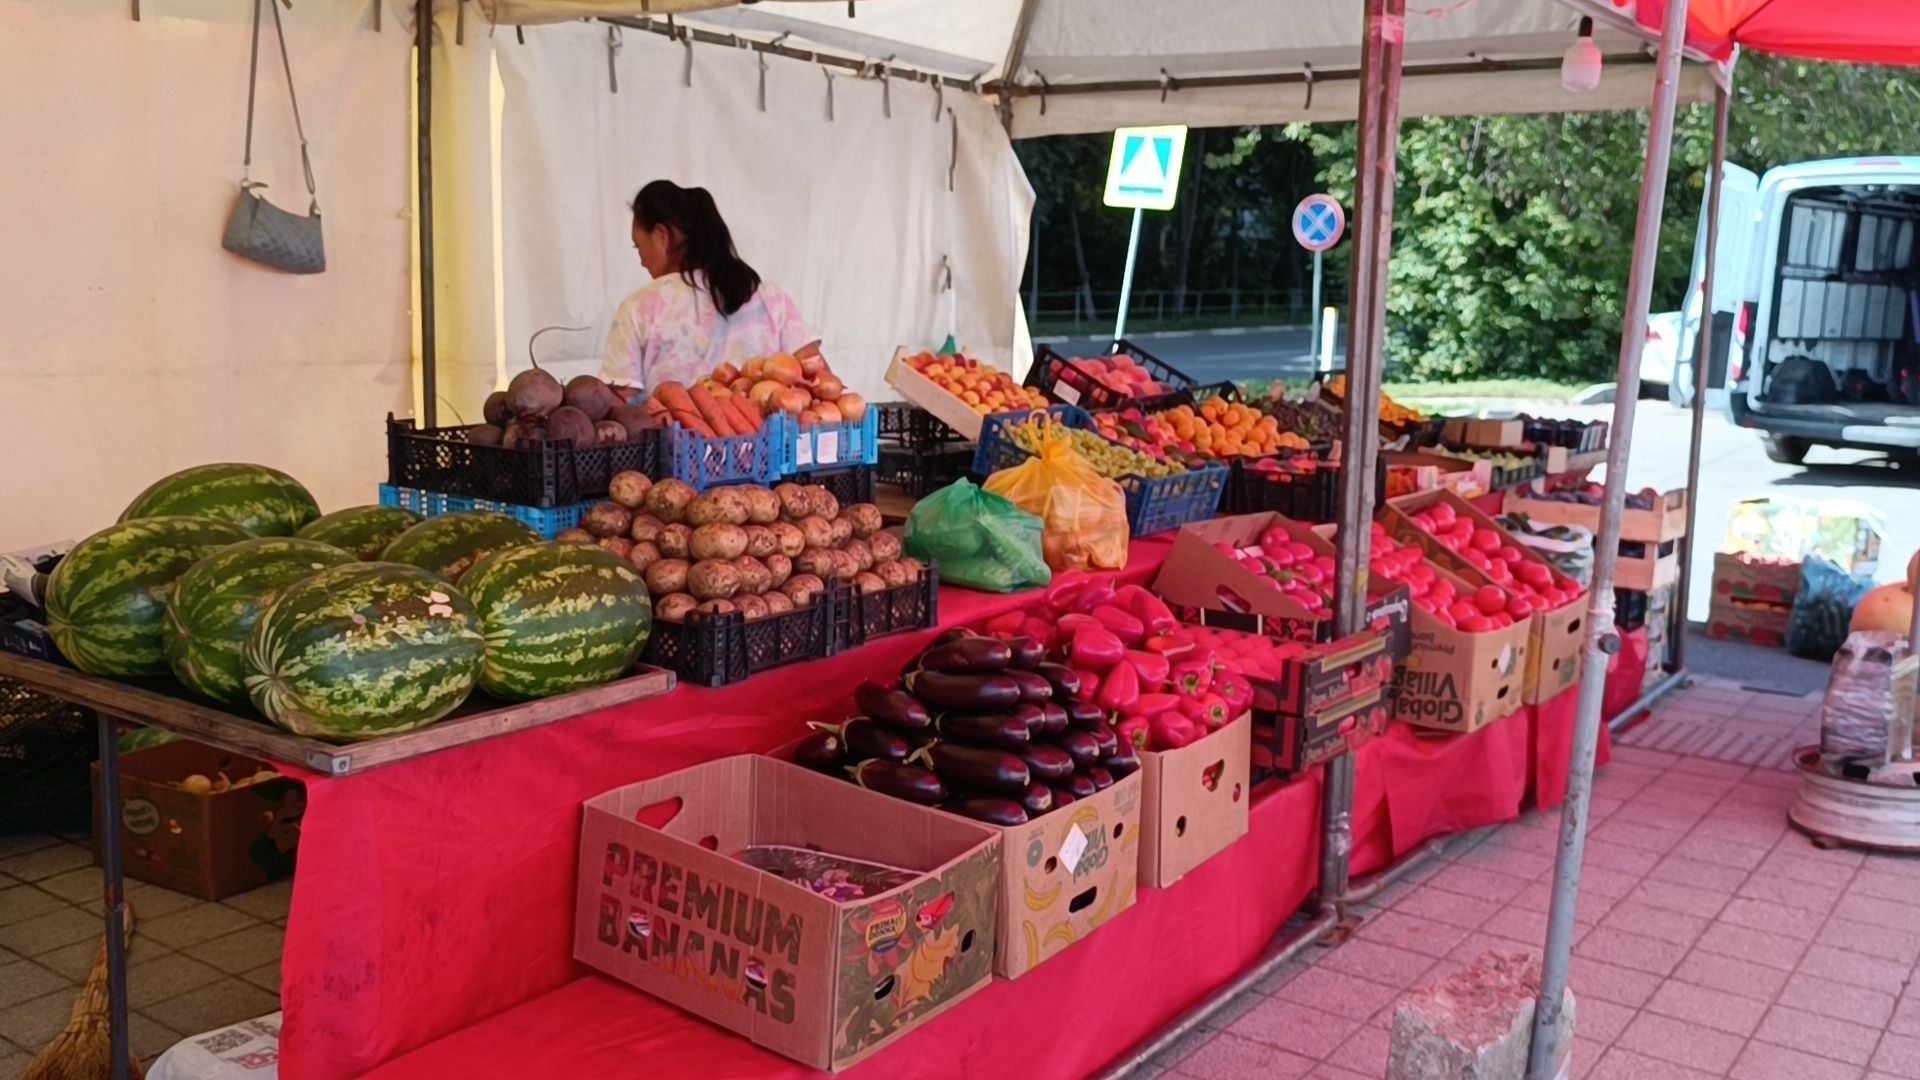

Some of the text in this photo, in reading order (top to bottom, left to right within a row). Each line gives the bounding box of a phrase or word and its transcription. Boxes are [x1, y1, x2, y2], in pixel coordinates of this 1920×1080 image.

[1391, 697, 1464, 724] Global
[598, 892, 797, 1025] BANANAS
[602, 842, 804, 966] PREMIUM
